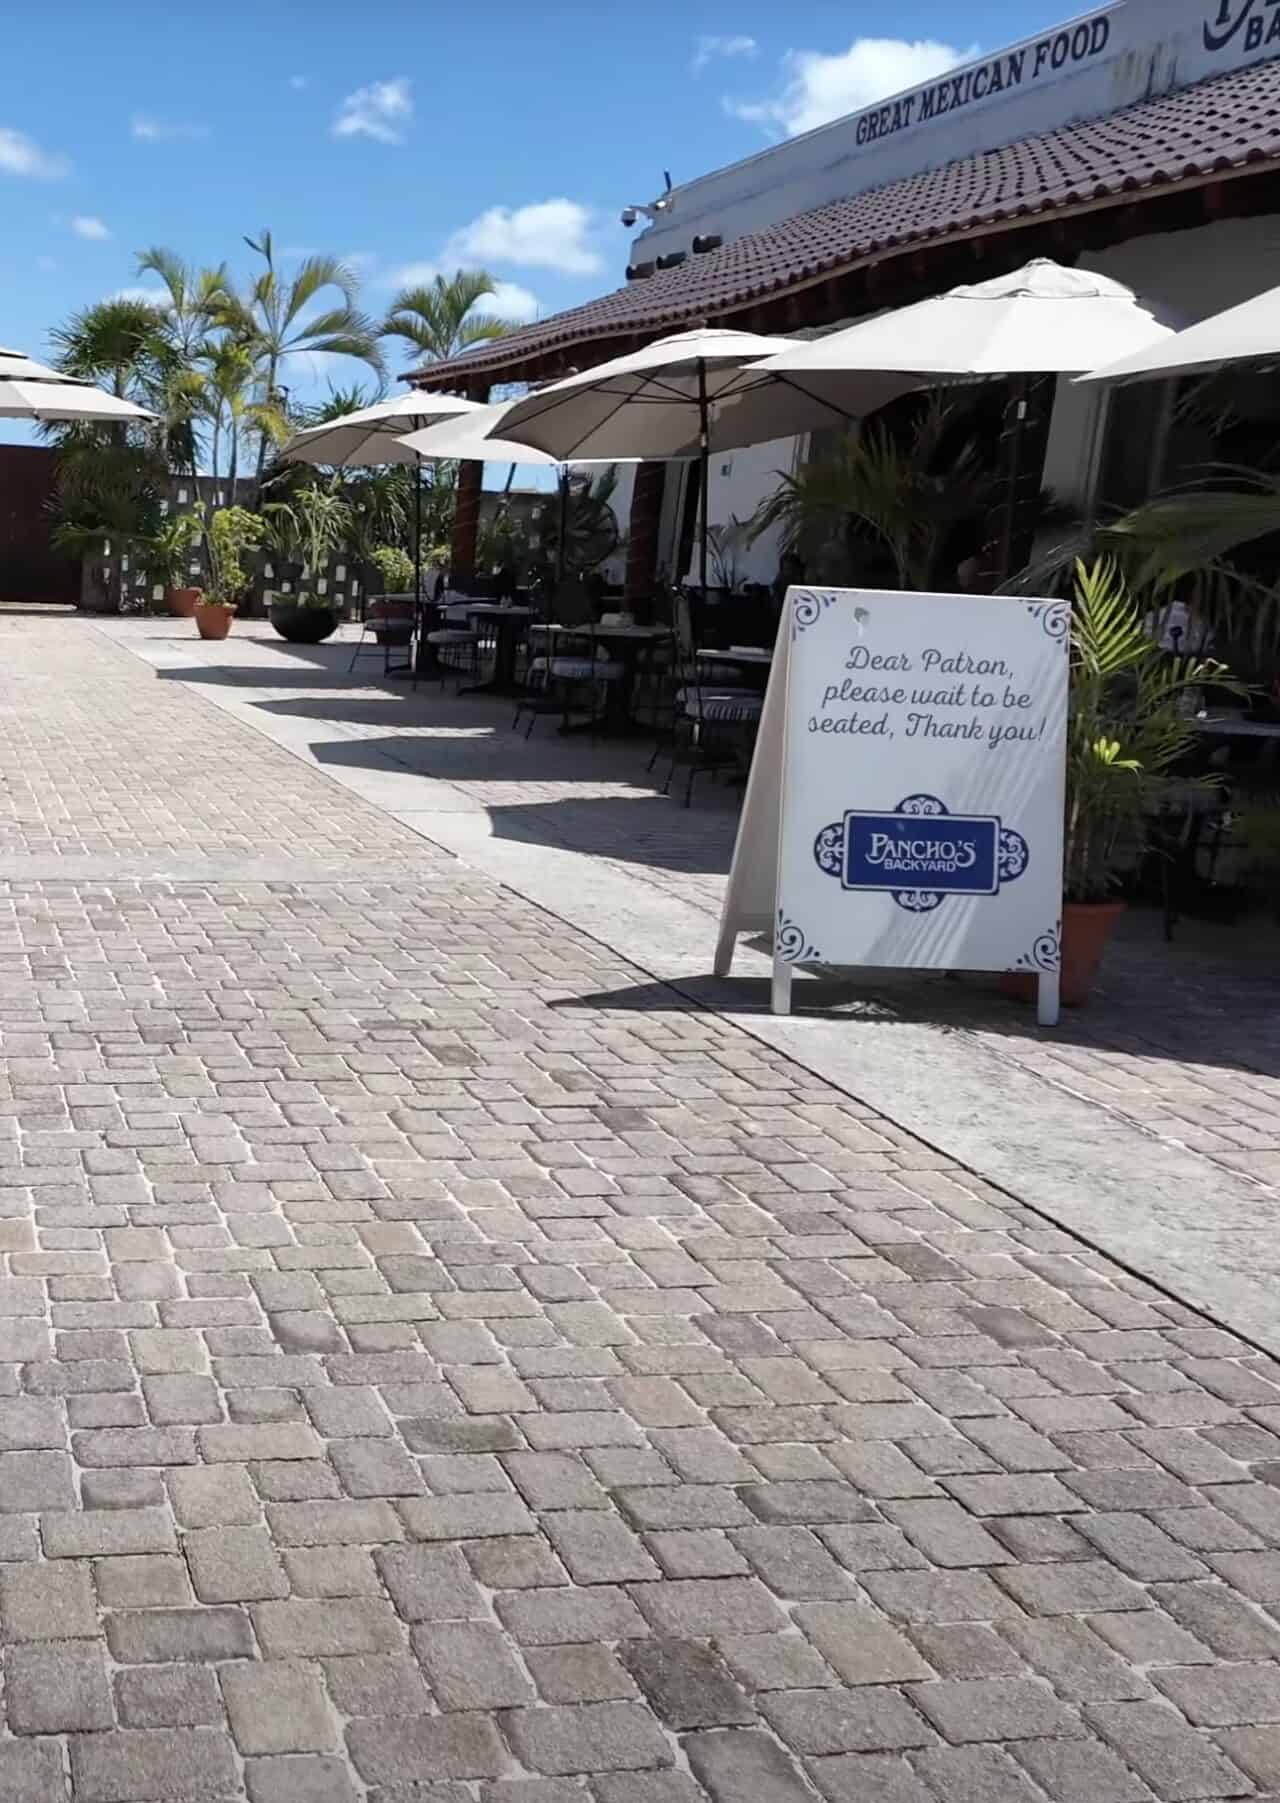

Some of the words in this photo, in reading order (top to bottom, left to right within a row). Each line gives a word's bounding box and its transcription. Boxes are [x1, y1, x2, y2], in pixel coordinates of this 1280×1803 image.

[855, 96, 915, 145] GREAT
[917, 51, 1024, 122] MEXICAN
[1032, 15, 1110, 79] FOOD
[845, 645, 912, 671] Dear
[922, 648, 1015, 679] Patron,
[821, 678, 908, 709] please
[911, 683, 967, 706] wait
[970, 684, 997, 707] to
[1002, 685, 1033, 708] be
[807, 711, 896, 740] seated,
[905, 712, 984, 739] Thank
[987, 717, 1047, 750] you!
[865, 832, 977, 868] PANCHO'S
[883, 858, 957, 873] BACKYARD
